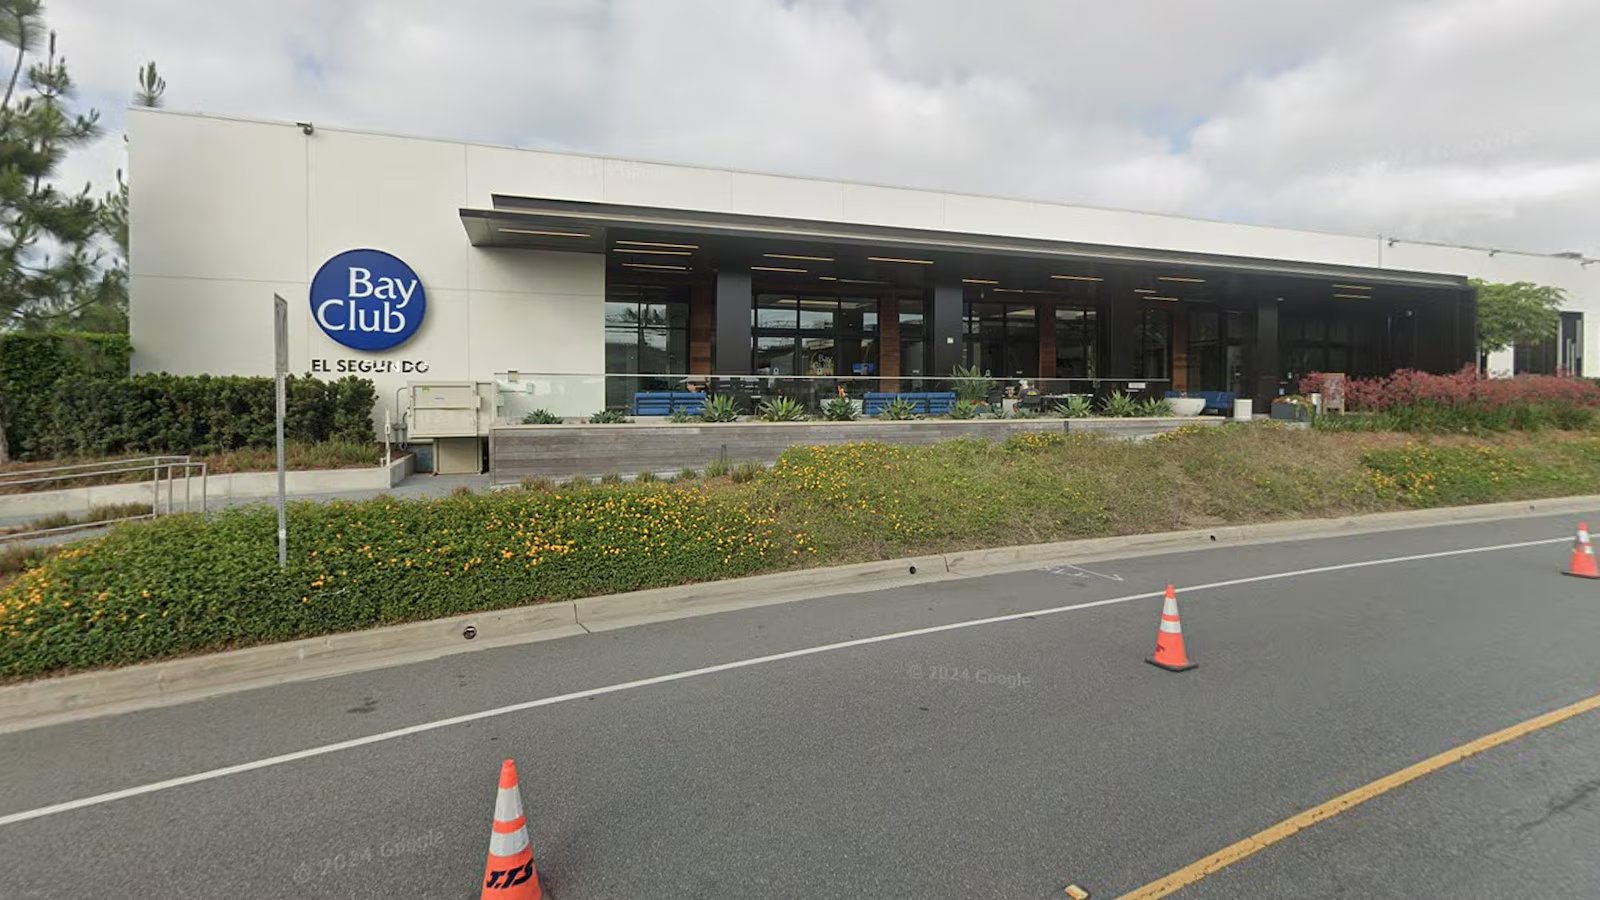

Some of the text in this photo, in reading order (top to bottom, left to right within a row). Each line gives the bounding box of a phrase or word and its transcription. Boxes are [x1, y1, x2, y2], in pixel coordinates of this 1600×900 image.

[349, 267, 417, 309] Bay
[317, 299, 405, 333] Club
[312, 360, 429, 373] EL SEGUNDO
